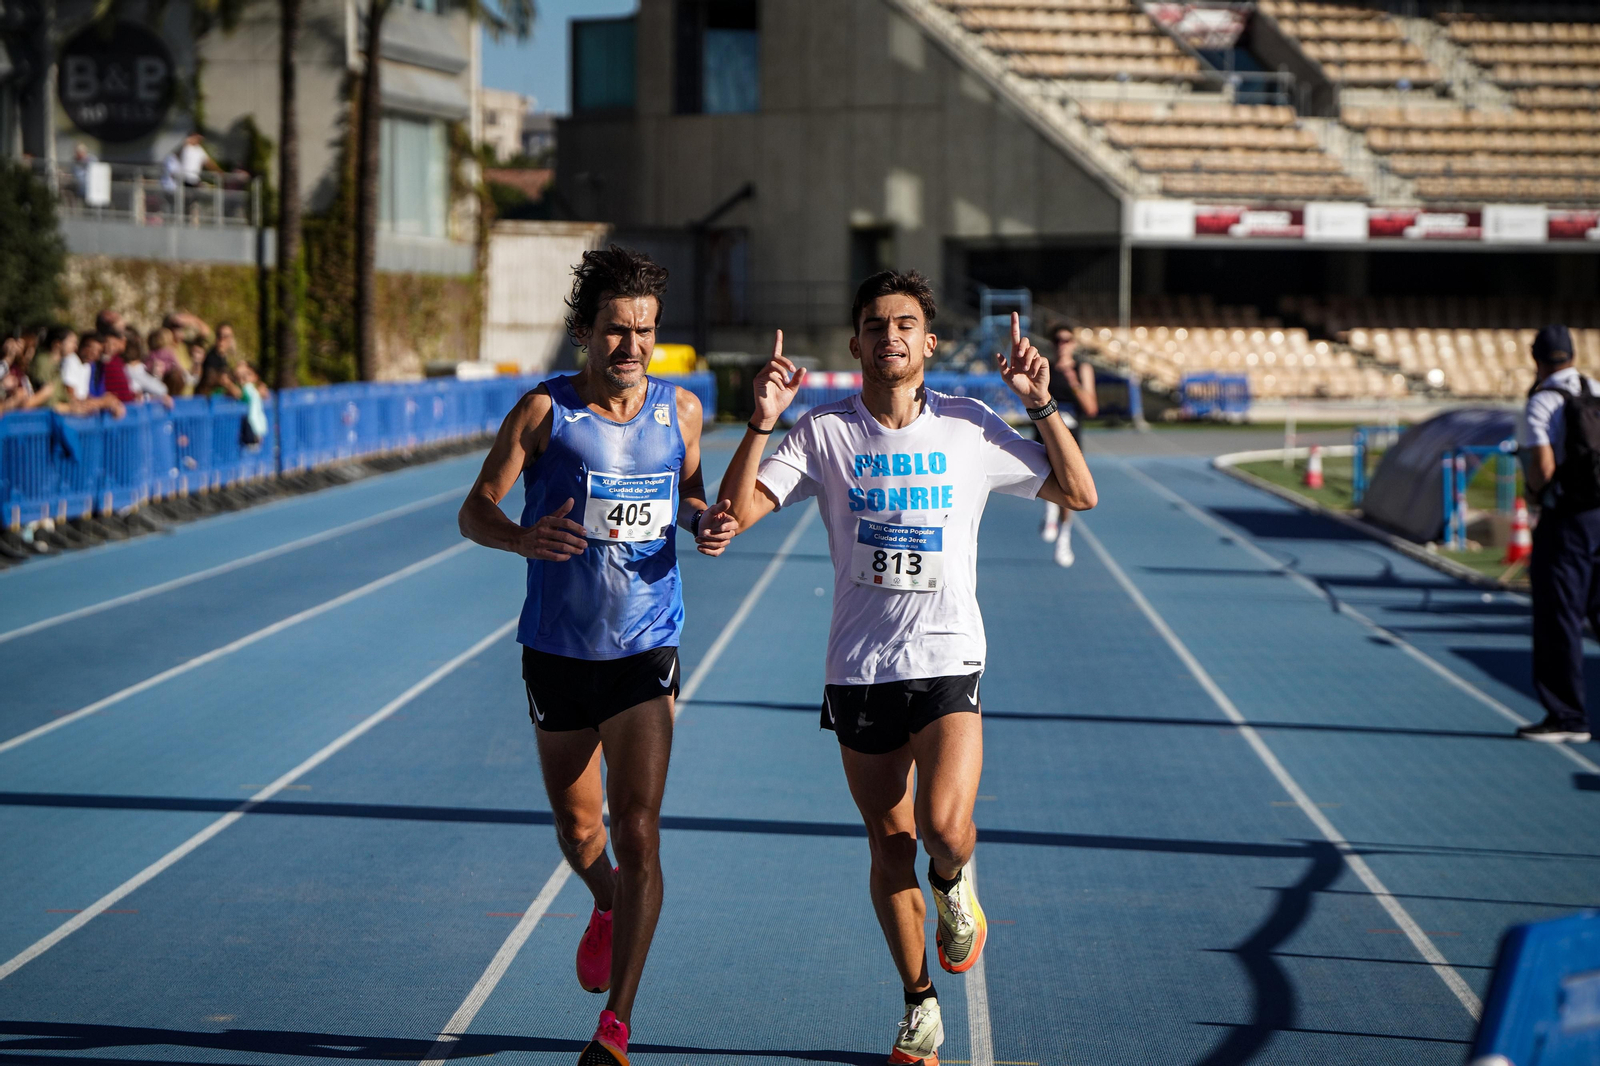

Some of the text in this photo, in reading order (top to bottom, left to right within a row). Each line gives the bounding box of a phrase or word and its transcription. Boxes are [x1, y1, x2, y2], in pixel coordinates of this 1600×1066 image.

[855, 452, 947, 477] PABLO
[644, 478, 666, 486] Popular
[848, 485, 953, 512] SONRIE
[607, 503, 651, 526] 405
[868, 523, 935, 536] XLIII Carrera Popular
[873, 533, 898, 542] Ciudad
[908, 536, 927, 544] Jerez
[872, 549, 922, 576] 813
